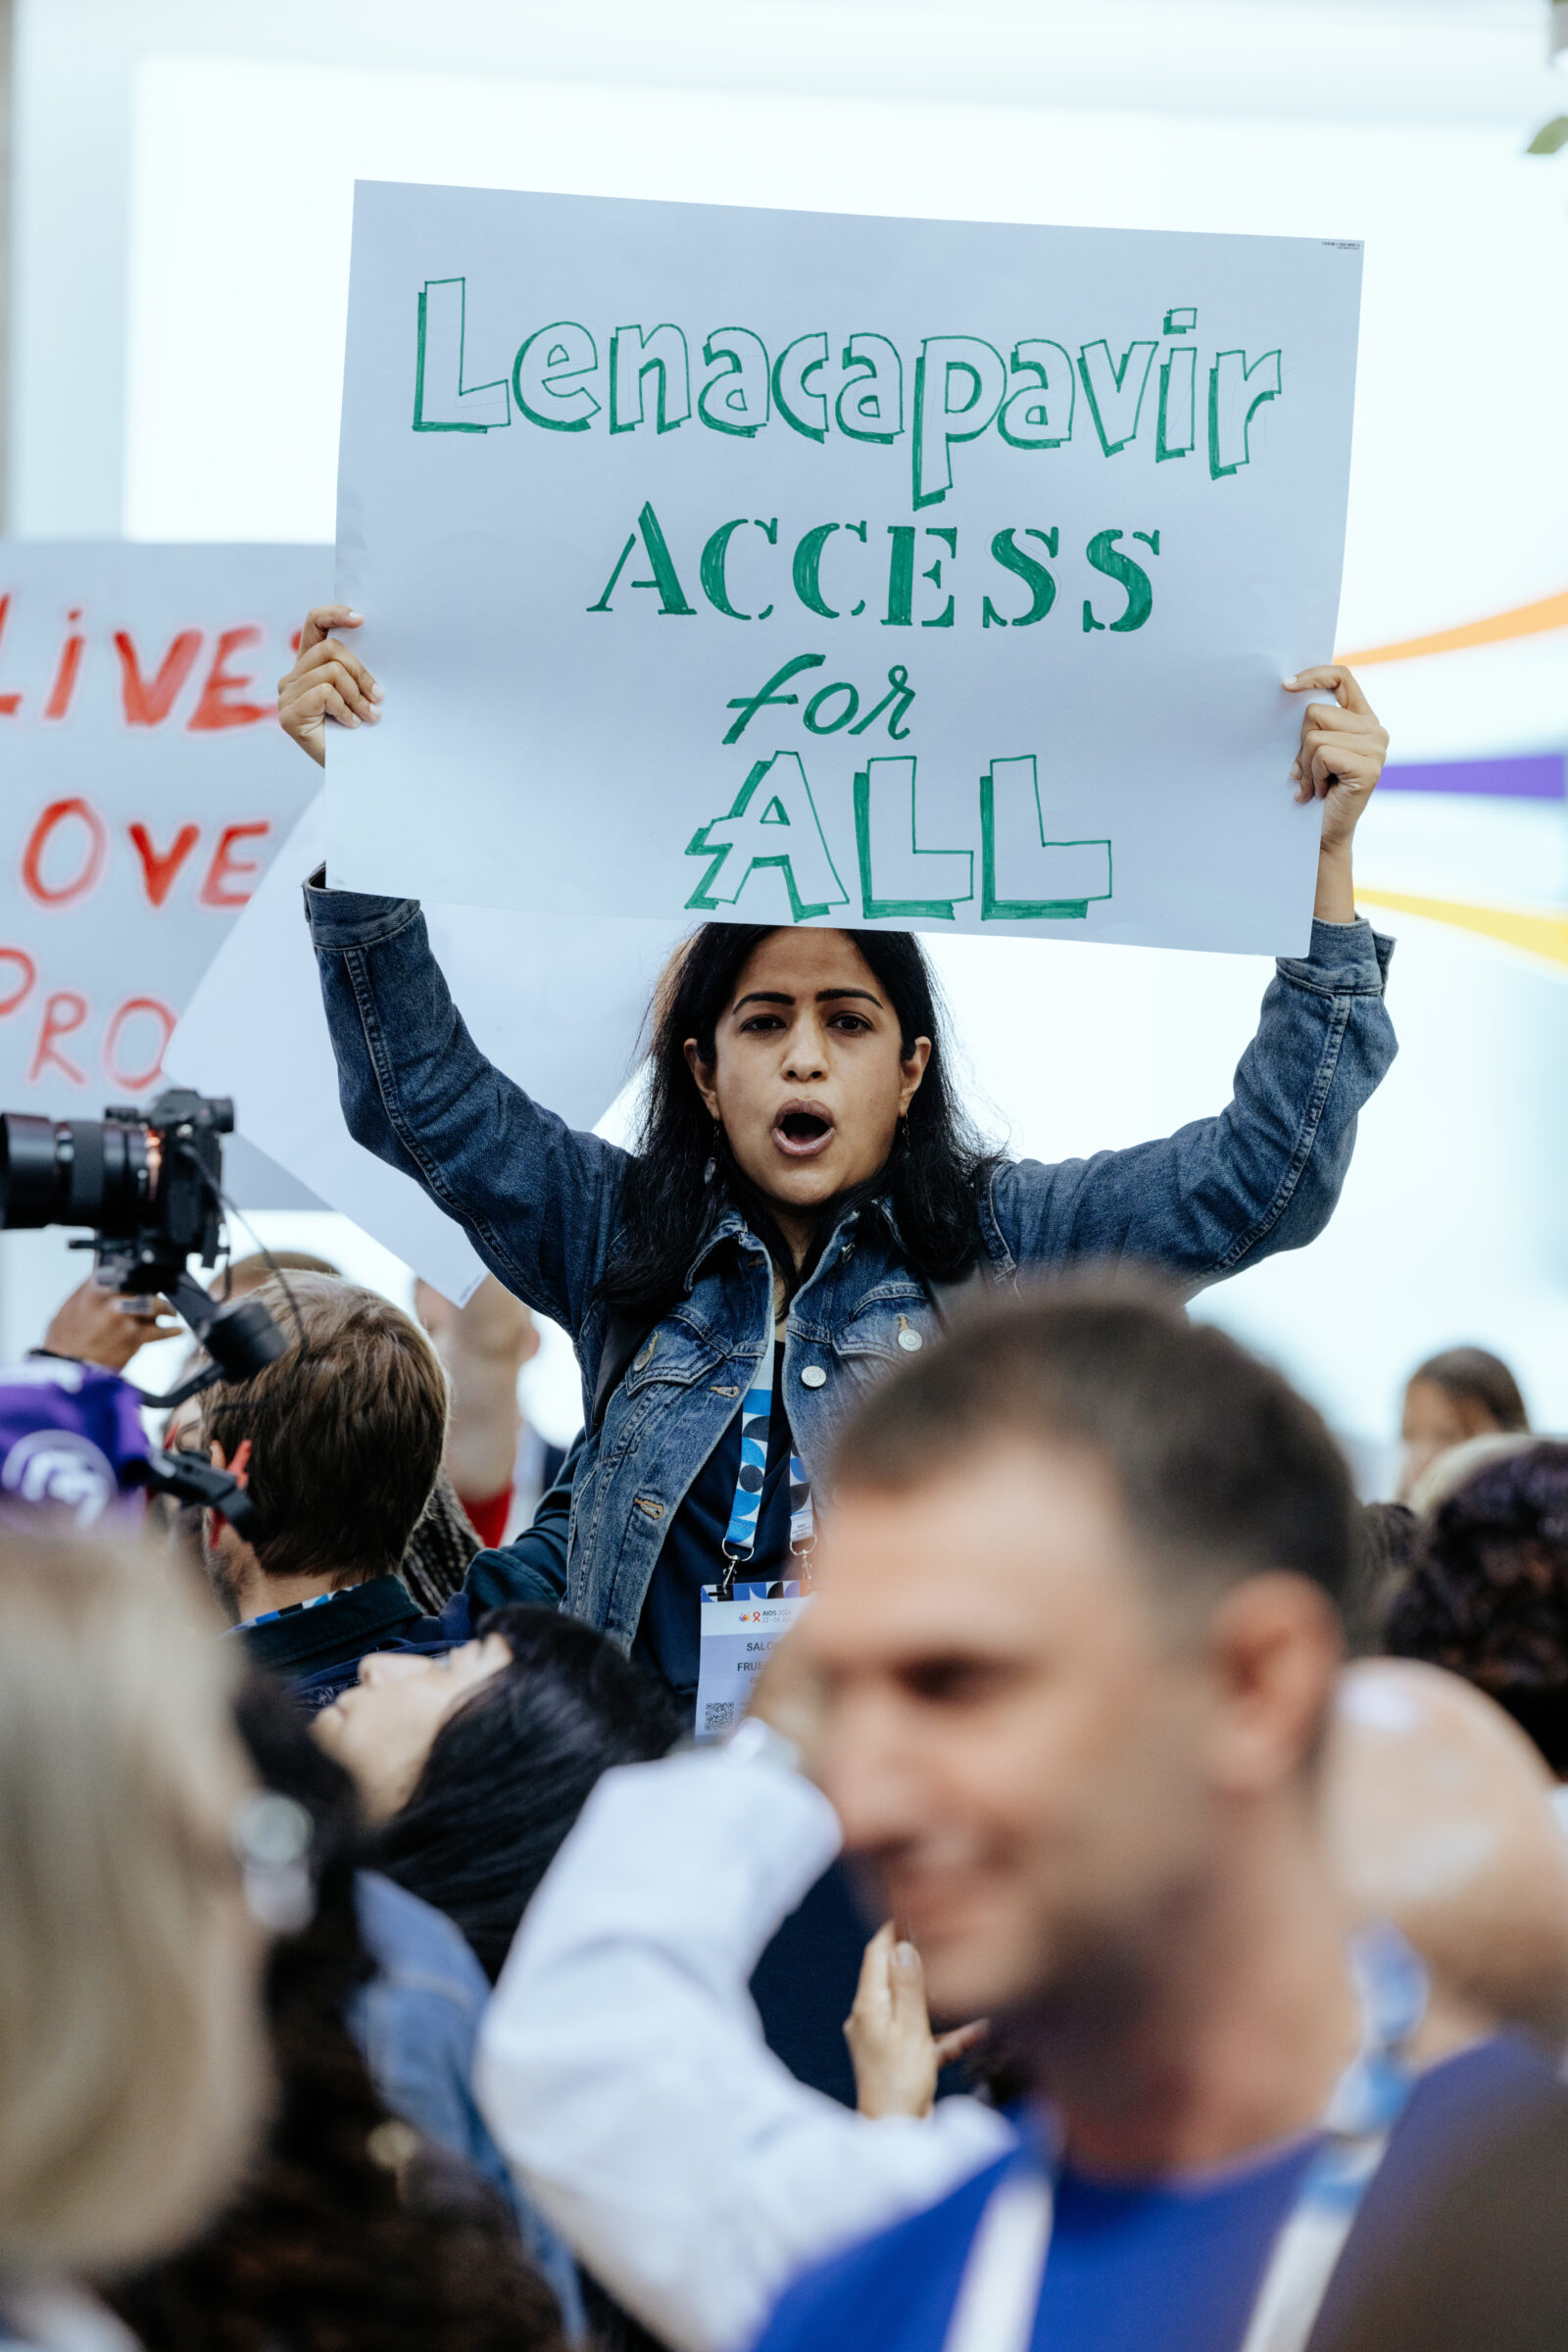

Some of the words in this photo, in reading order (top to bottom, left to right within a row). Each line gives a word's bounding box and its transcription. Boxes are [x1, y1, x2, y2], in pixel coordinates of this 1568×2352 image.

[412, 277, 1282, 511] Lenacapavir
[585, 500, 1160, 632] ACCESS
[721, 654, 915, 745] for
[683, 750, 1112, 921] ALL
[746, 1642, 777, 1651] SALO
